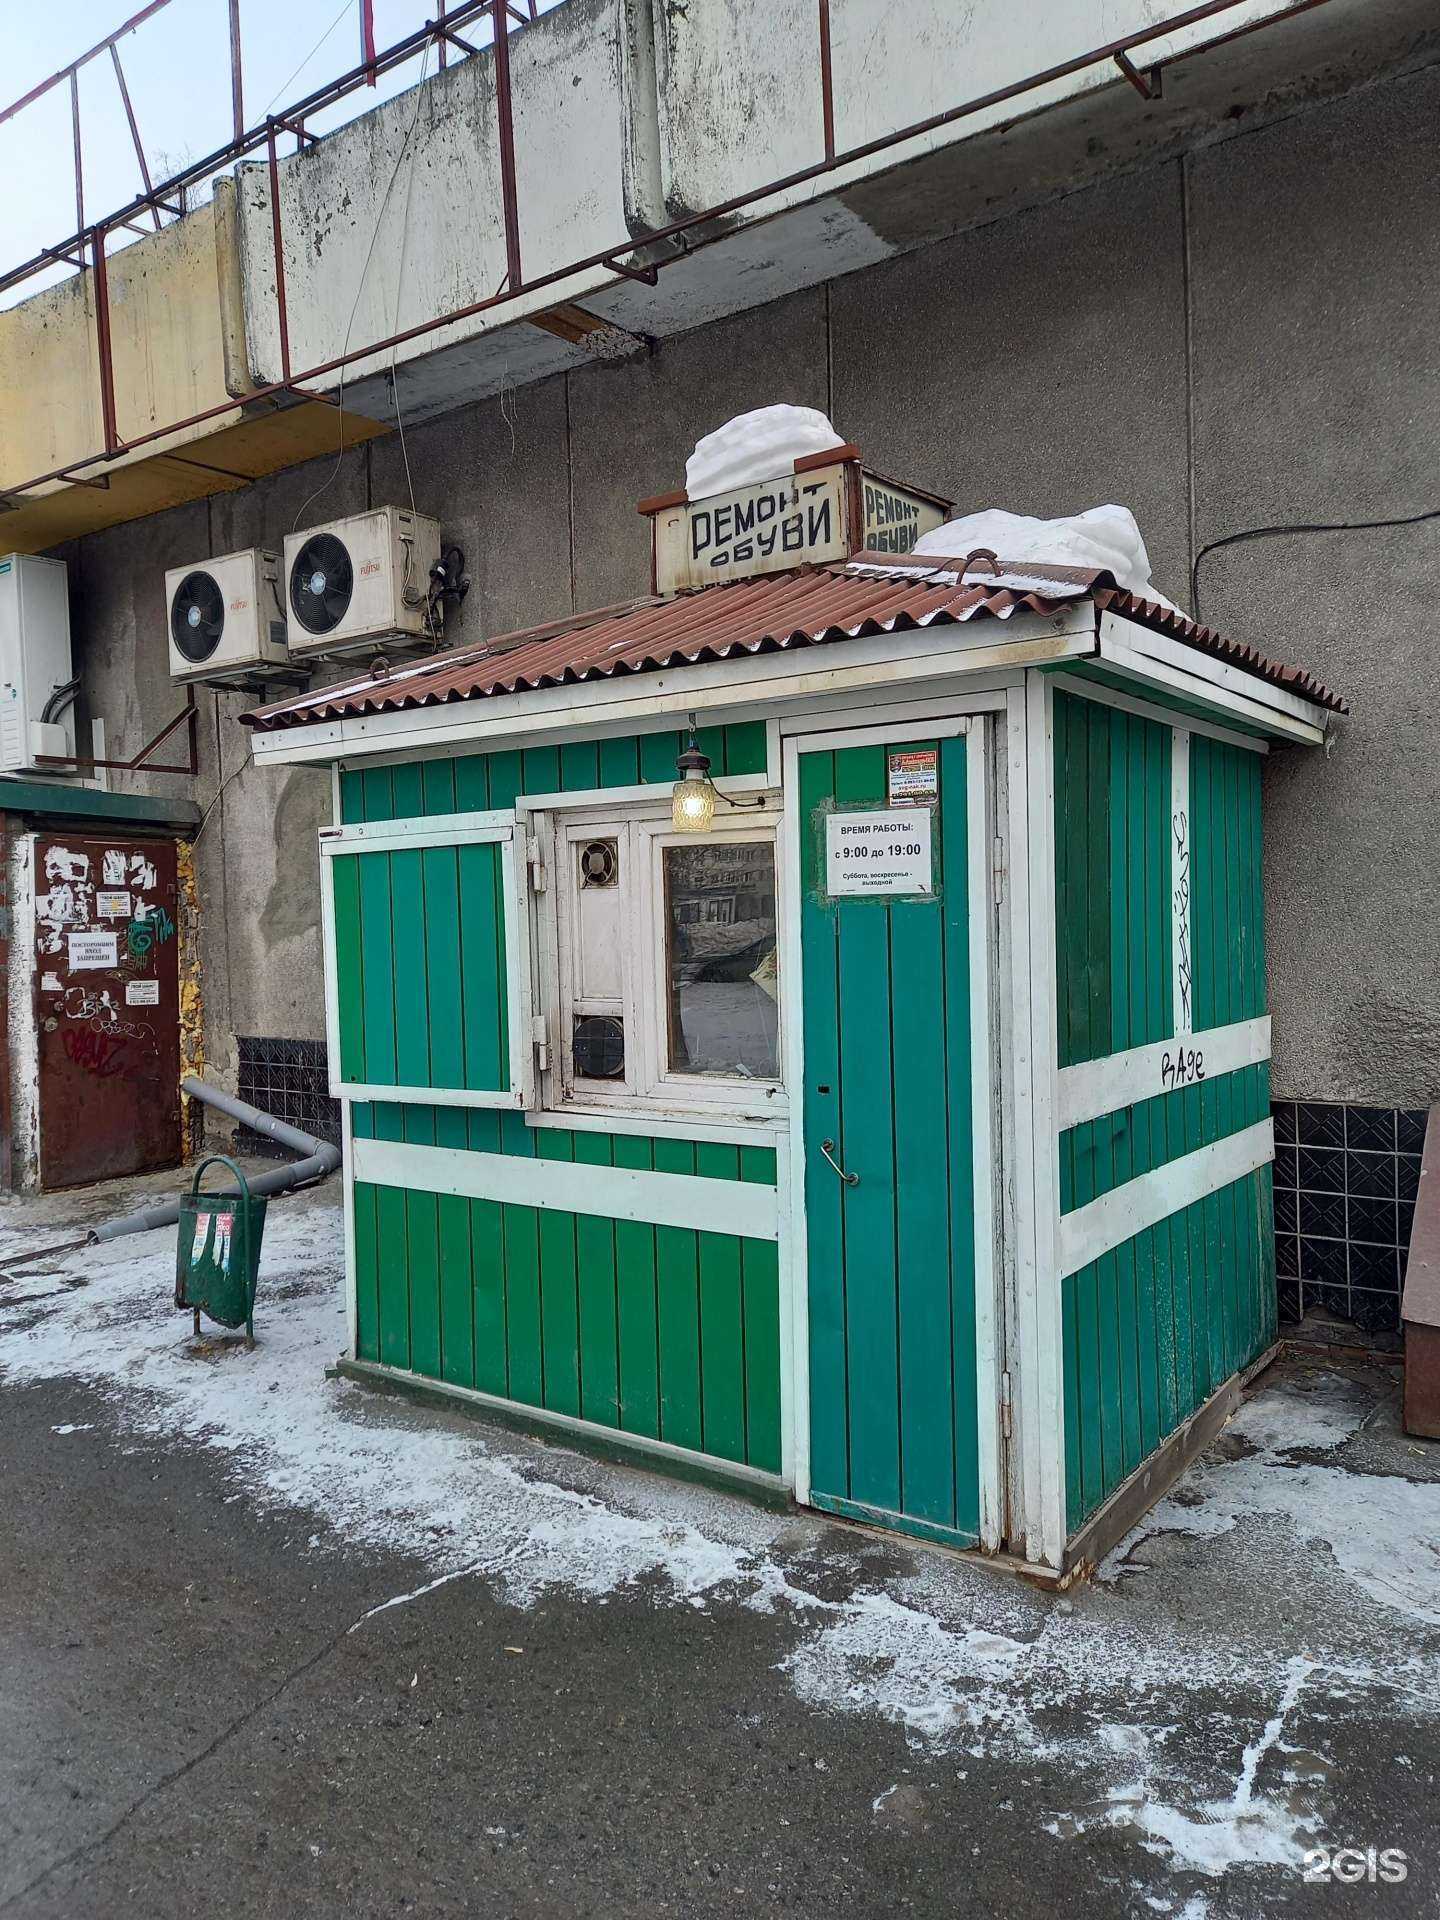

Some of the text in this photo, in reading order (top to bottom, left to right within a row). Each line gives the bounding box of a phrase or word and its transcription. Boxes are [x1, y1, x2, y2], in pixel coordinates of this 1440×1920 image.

[865, 485, 920, 527] РЕМОНТ
[691, 481, 828, 560] РЕМОНТ
[710, 497, 831, 567] ОБУВИ
[866, 522, 918, 554] ОБУВИ
[360, 563, 380, 575] FUJITSU
[841, 823, 914, 835] ВРЕМЯ РАБОТЫ:
[835, 843, 921, 859] с 9:00 до 19:00
[842, 872, 869, 880] Суббота,
[870, 871, 909, 879] воскресенье
[76, 954, 110, 962] ЗАПРЕЩЕН
